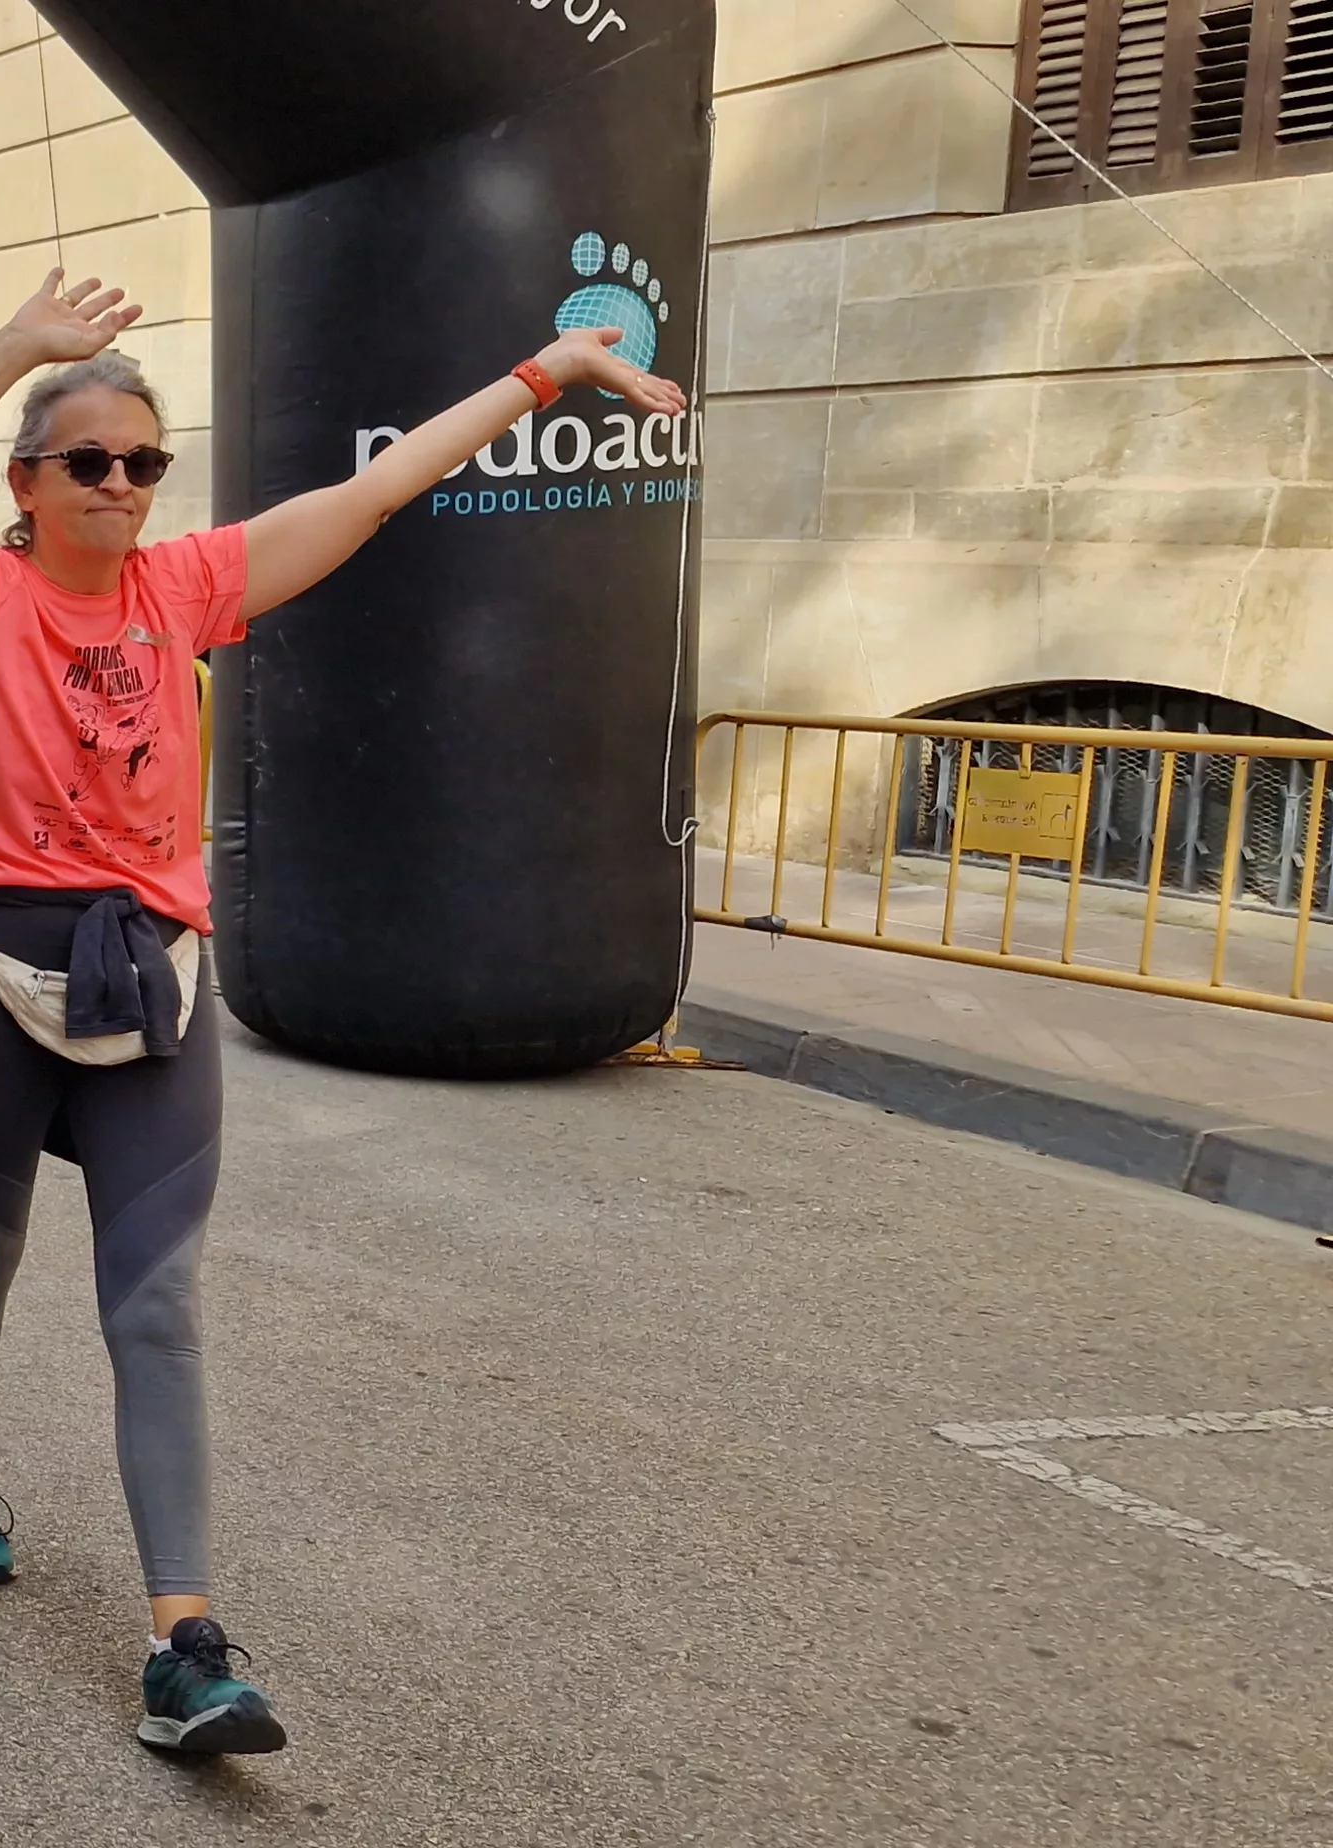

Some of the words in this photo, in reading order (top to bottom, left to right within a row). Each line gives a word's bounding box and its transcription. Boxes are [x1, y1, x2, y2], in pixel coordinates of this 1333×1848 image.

[433, 477, 613, 516] PODOLOGÍA
[622, 482, 636, 506] Y
[63, 663, 93, 691] POR
